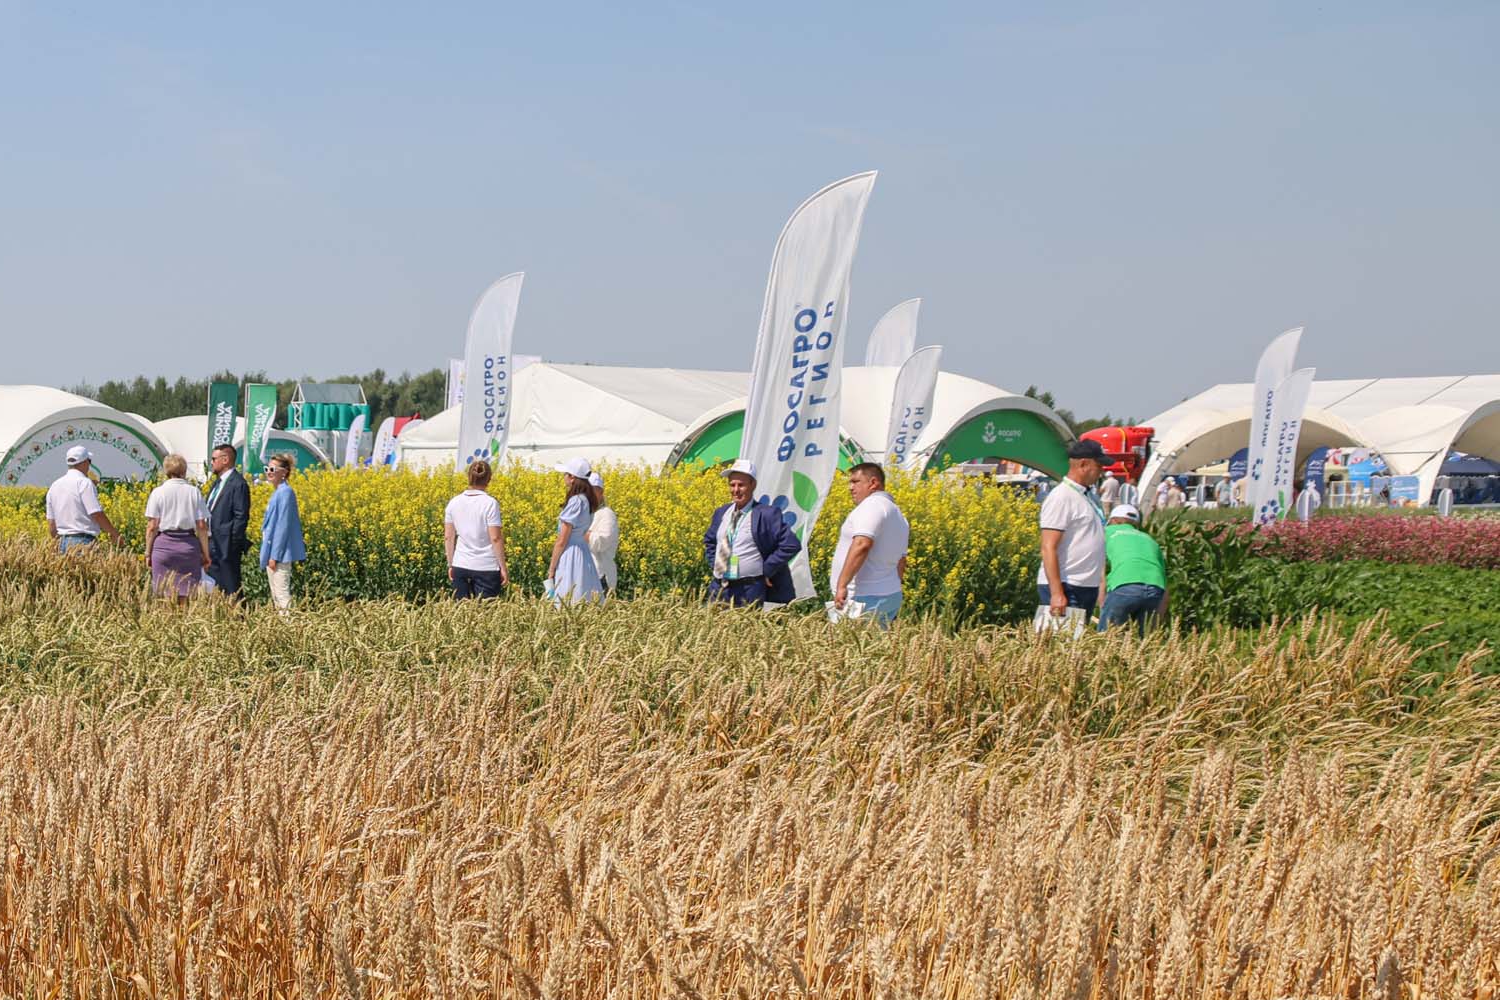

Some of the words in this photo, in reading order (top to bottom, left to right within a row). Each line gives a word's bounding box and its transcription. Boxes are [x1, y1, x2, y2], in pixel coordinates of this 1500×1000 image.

[484, 357, 495, 433] ФОСАГРО
[777, 308, 818, 462] ФОСАГРО
[212, 401, 226, 449] EKONIVA
[220, 405, 232, 445] ОНИВА
